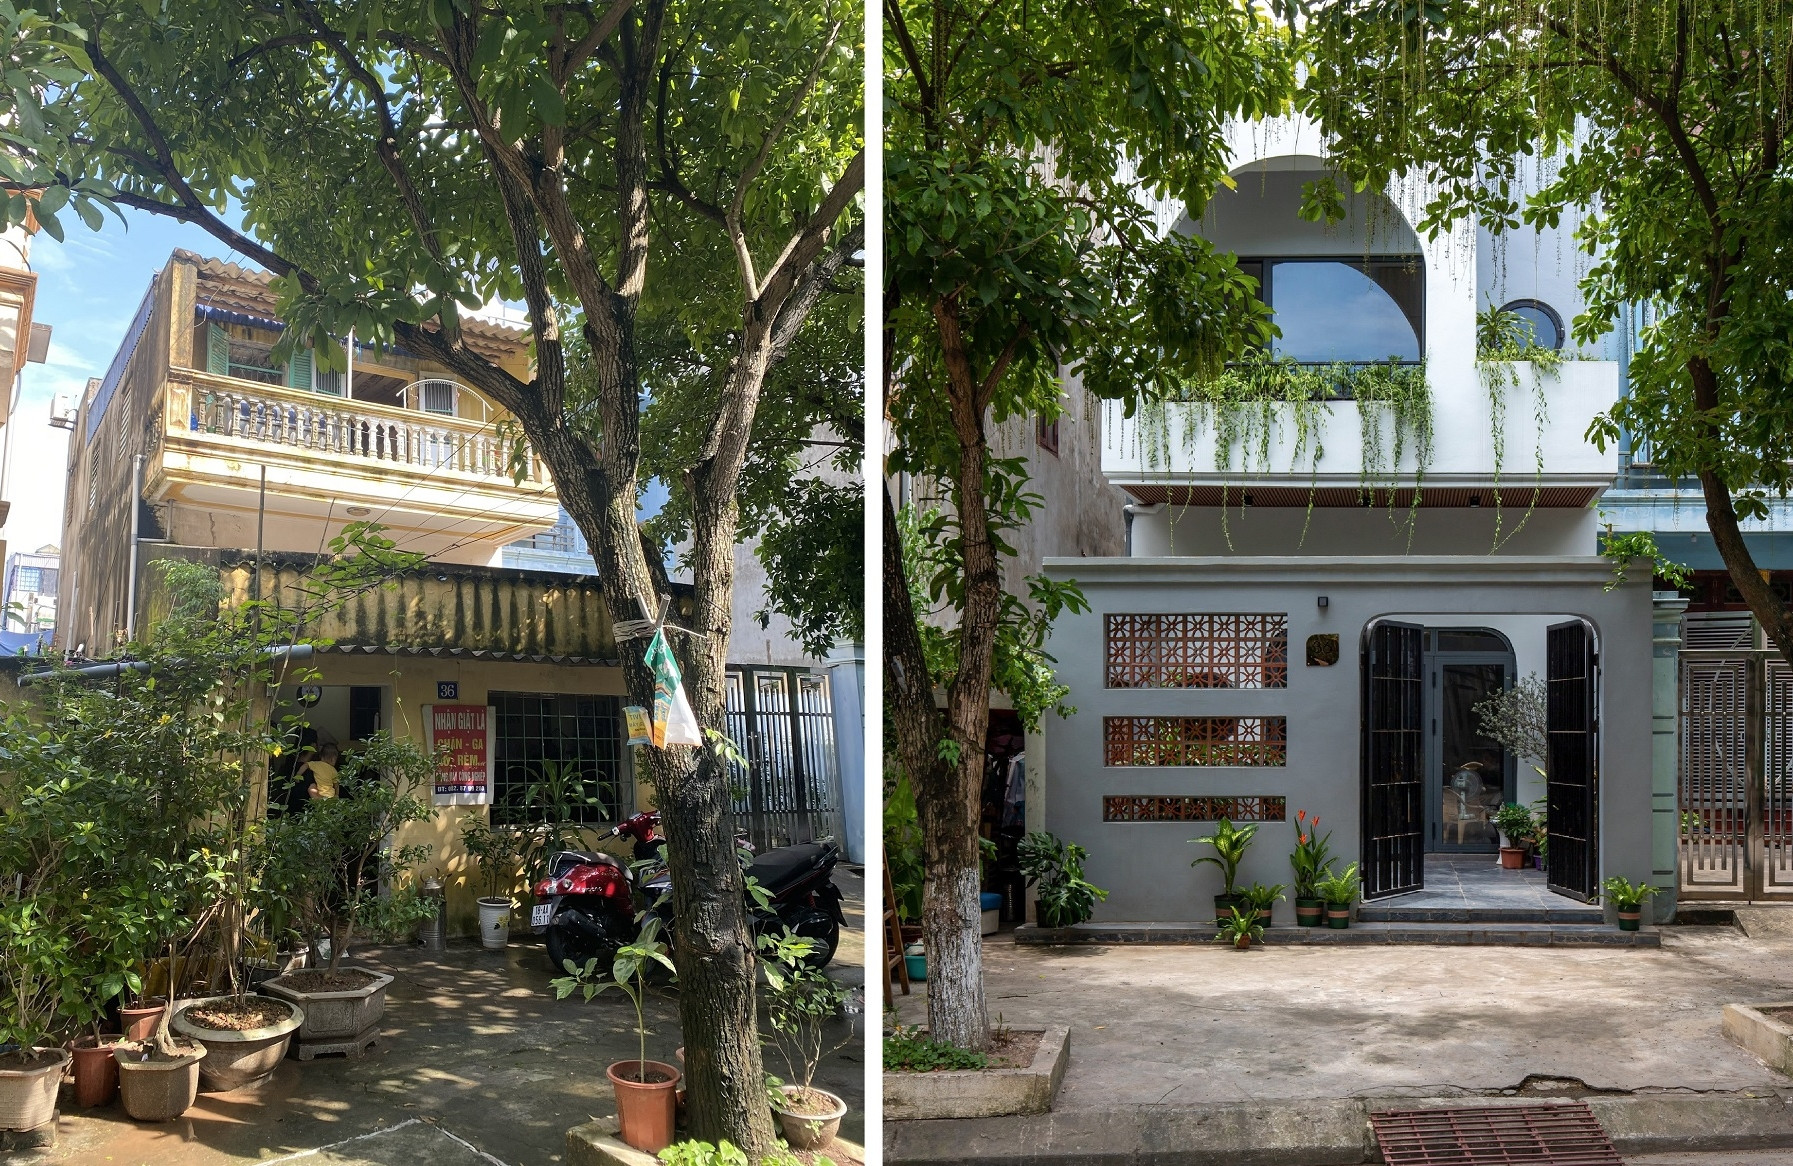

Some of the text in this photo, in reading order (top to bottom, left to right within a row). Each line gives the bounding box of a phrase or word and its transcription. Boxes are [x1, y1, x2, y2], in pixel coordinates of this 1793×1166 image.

[440, 684, 455, 697] 36
[434, 709, 457, 734] NHẬN
[458, 709, 475, 734] GIẶT
[472, 738, 484, 750] GA
